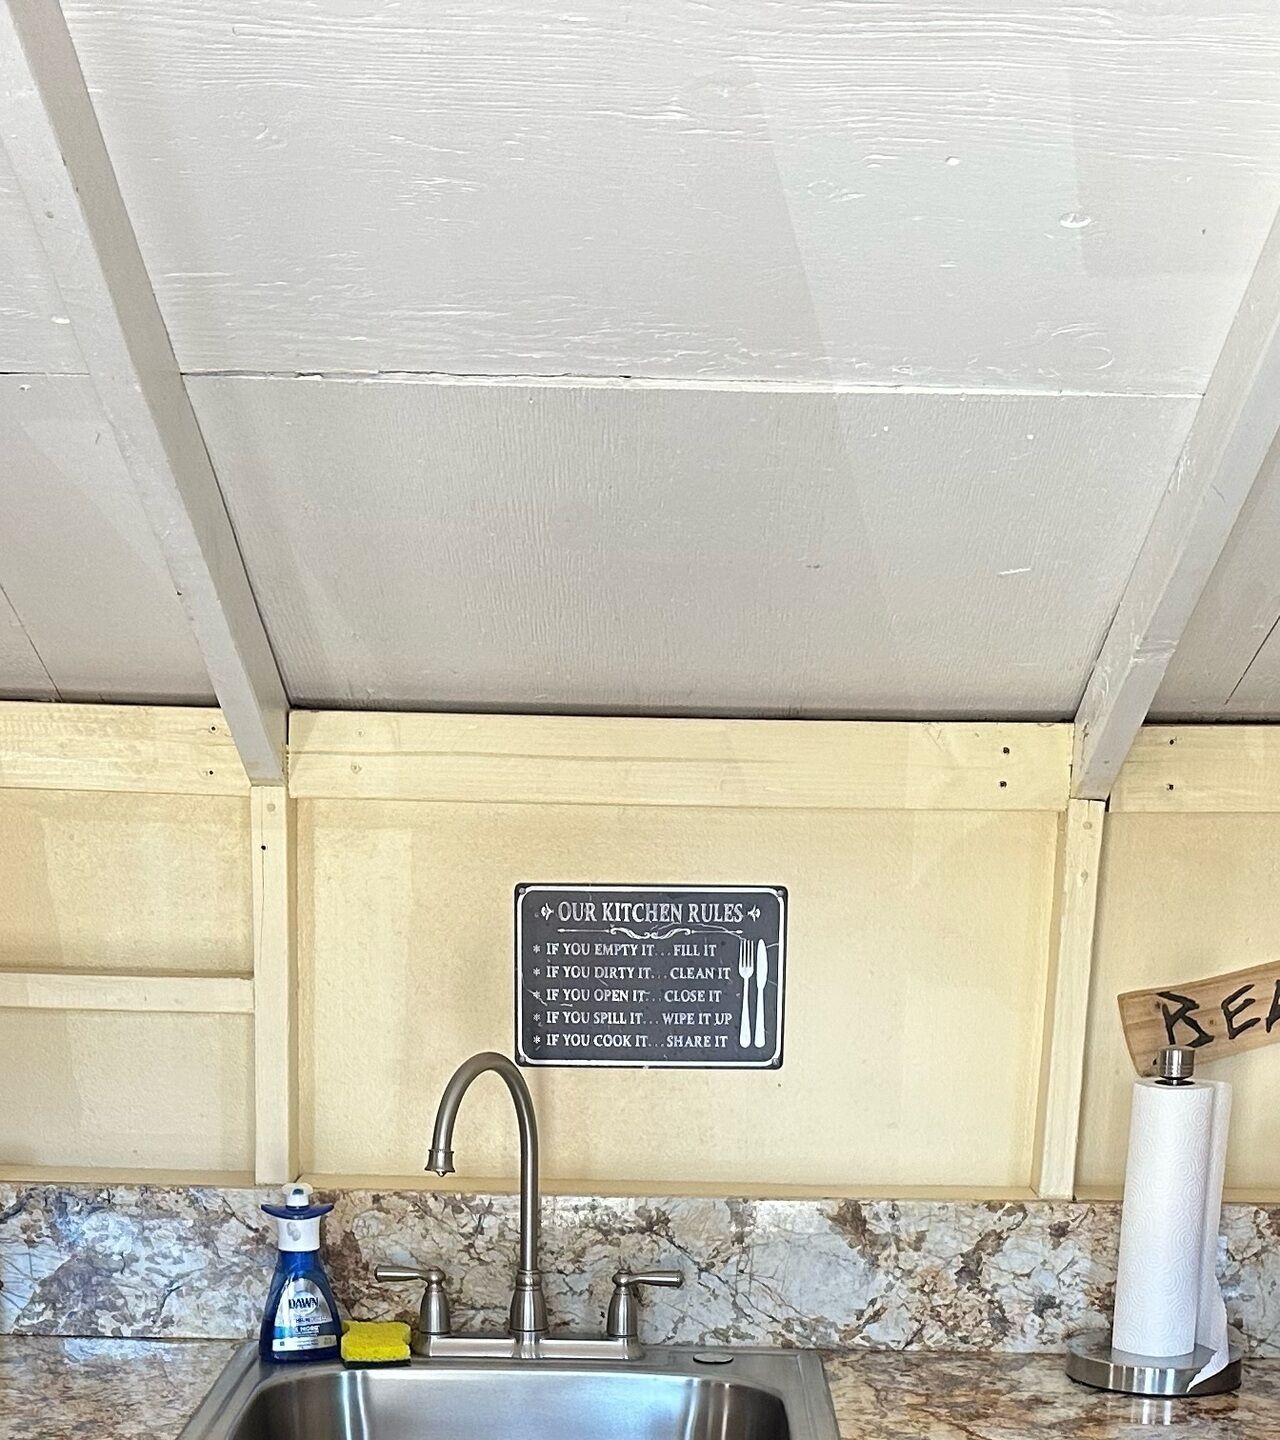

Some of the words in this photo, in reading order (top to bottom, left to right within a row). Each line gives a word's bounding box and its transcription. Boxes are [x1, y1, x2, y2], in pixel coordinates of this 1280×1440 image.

[557, 901, 598, 922] OUR
[602, 902, 683, 923] KITCHEN
[687, 903, 744, 923] RULES
[546, 942, 560, 955] IF
[562, 942, 591, 955] YOU
[594, 943, 639, 956] EMPTY
[673, 944, 701, 956] FILL
[703, 944, 717, 956] IT
[546, 965, 560, 978] IF
[562, 965, 591, 978] YOU
[594, 966, 635, 979] DIRTY
[669, 967, 715, 979] CLEAN
[717, 967, 732, 979] IT
[546, 988, 560, 1001] IF
[562, 988, 591, 1001] YOU
[593, 989, 629, 1003] OPEN
[663, 990, 706, 1003] CLOSE
[709, 990, 723, 1003] IT
[546, 1011, 560, 1024] IF
[562, 1011, 591, 1024] YOU
[593, 1012, 627, 1025] SPILL
[662, 1013, 696, 1025] WIPE
[698, 1013, 712, 1025] IT
[715, 1013, 733, 1025] UP
[546, 1033, 560, 1046] IF
[562, 1033, 591, 1046] YOU
[593, 1034, 632, 1048] COOK
[666, 1035, 712, 1048] SHARE
[714, 1035, 729, 1048] IT
[288, 1297, 319, 1310] DAWN
